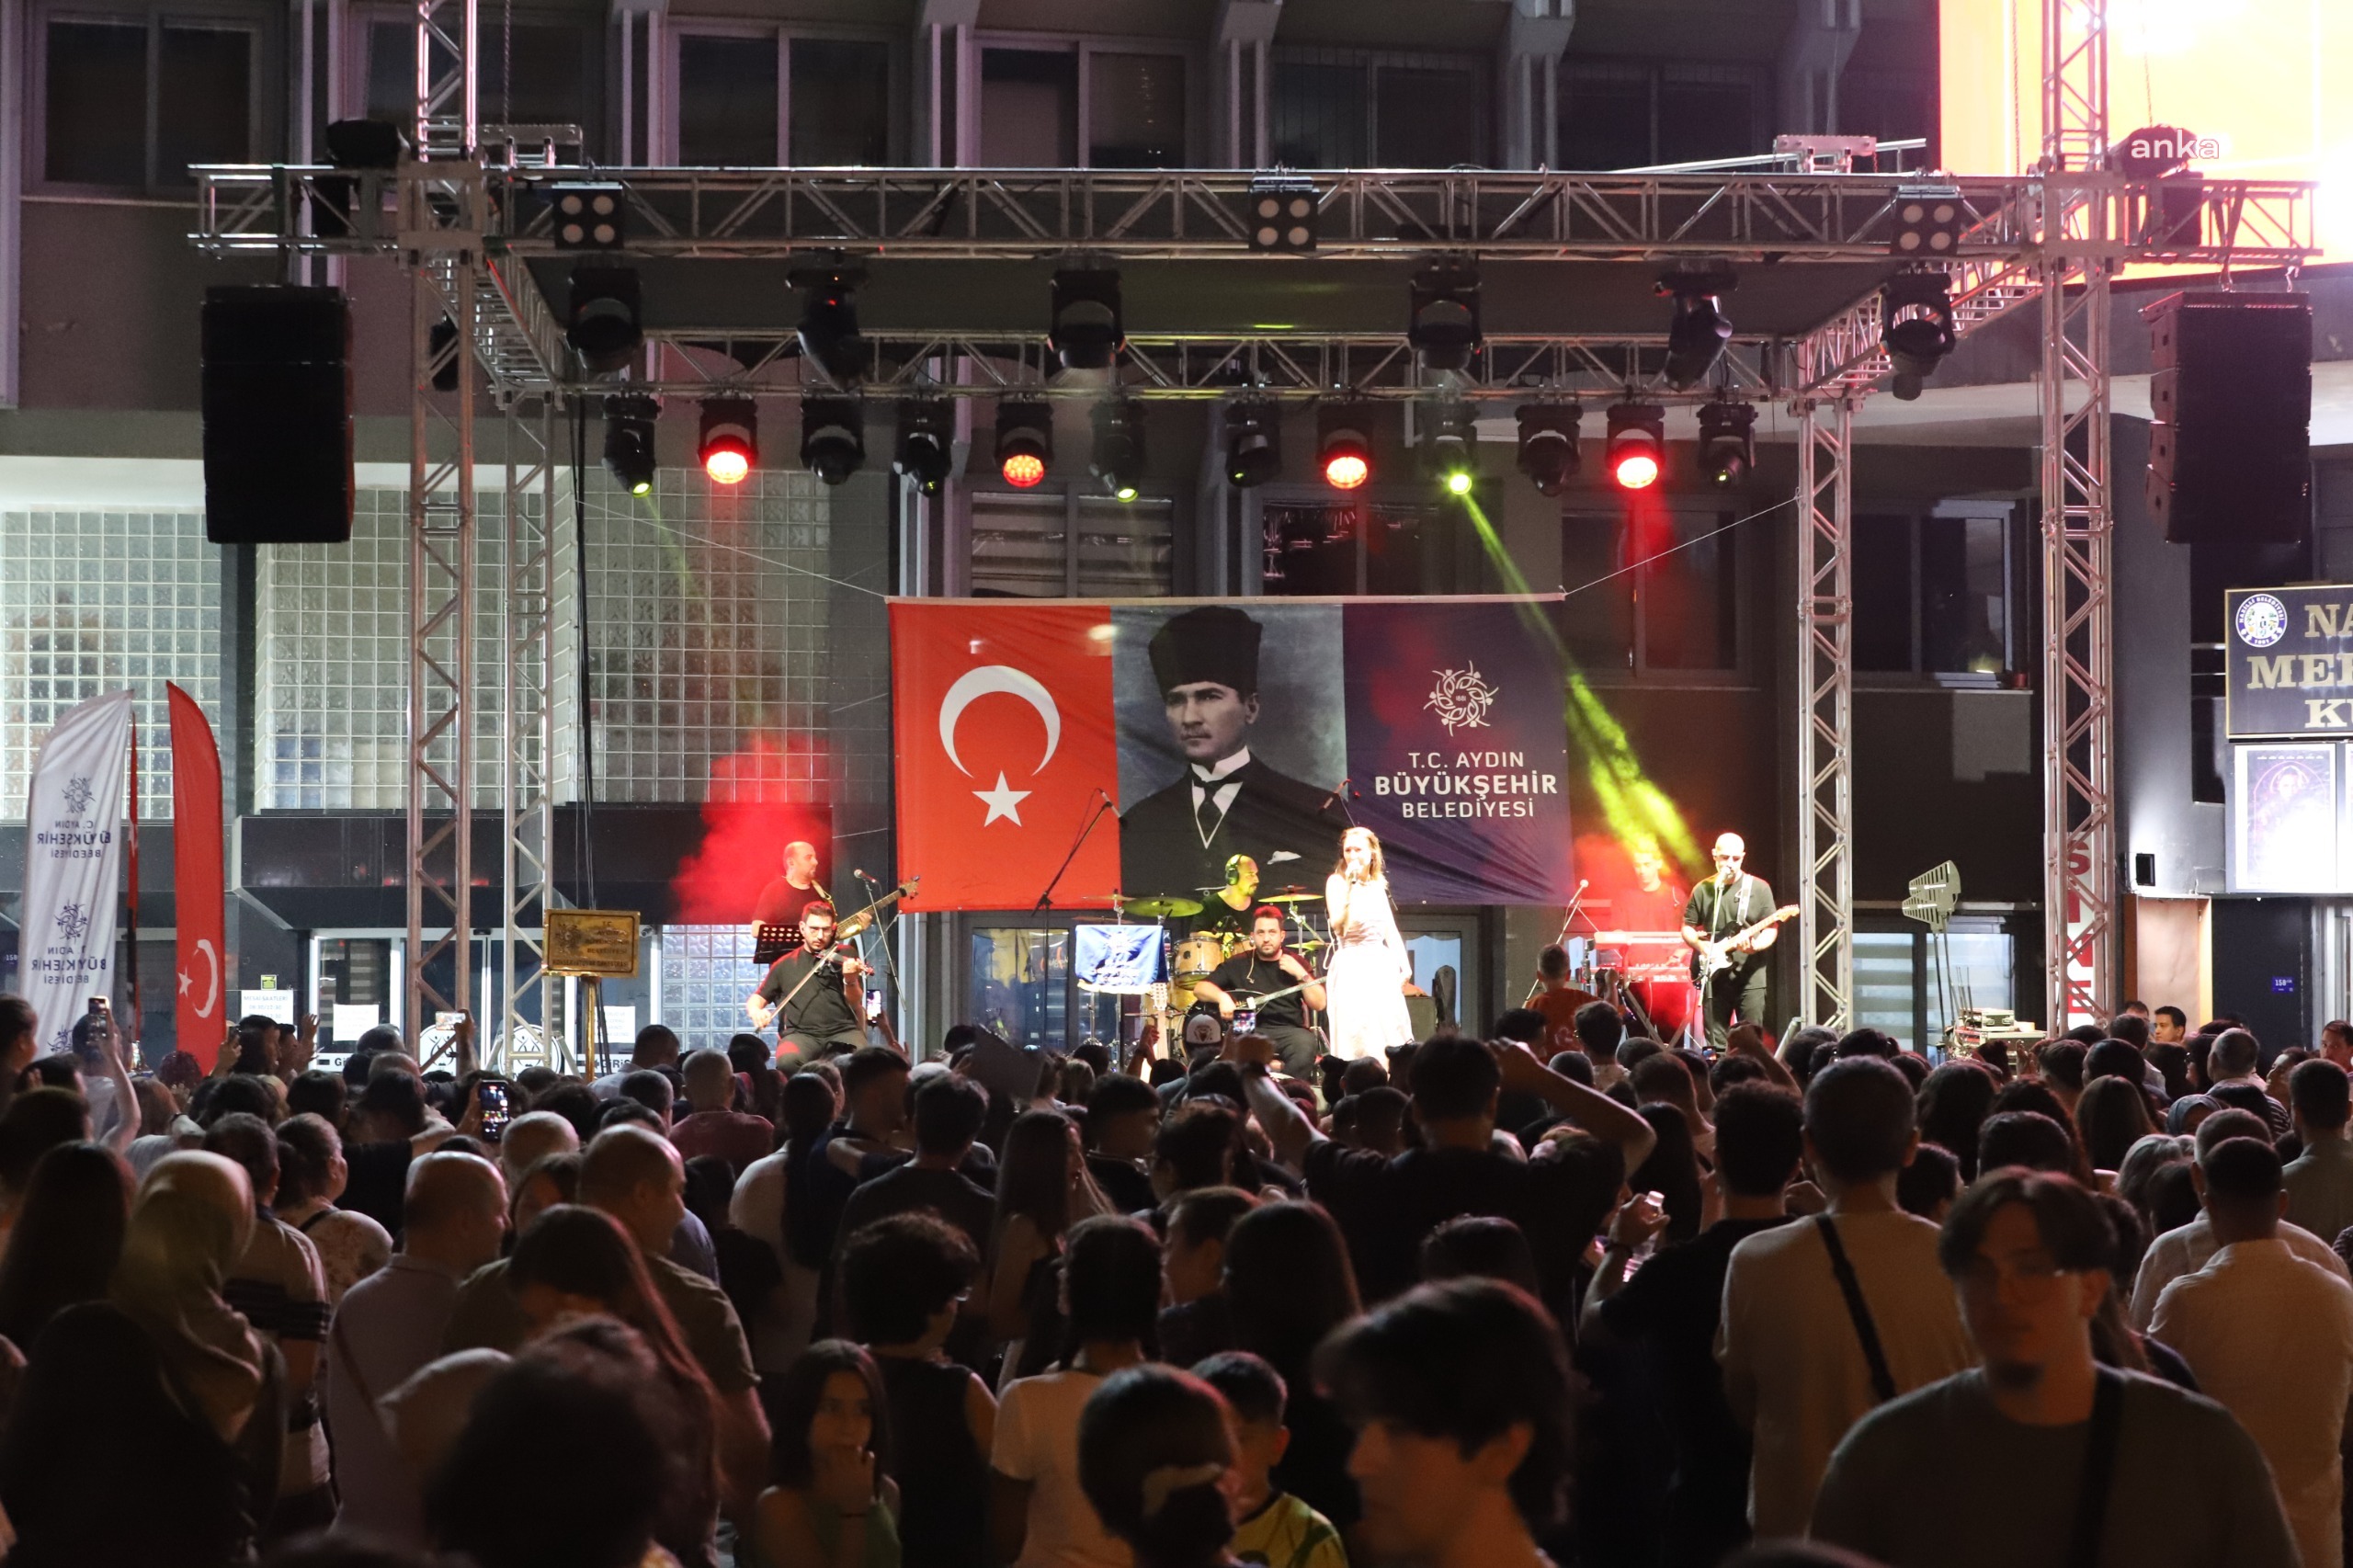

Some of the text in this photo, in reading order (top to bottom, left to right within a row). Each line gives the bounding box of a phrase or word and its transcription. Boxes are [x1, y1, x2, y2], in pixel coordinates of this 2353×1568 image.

[2304, 699, 2353, 728] K
[1408, 752, 1524, 768] T.C. AYDIN
[1375, 770, 1558, 800] BÜYÜKŞEHİR
[1402, 798, 1533, 818] BELEDİYESİ
